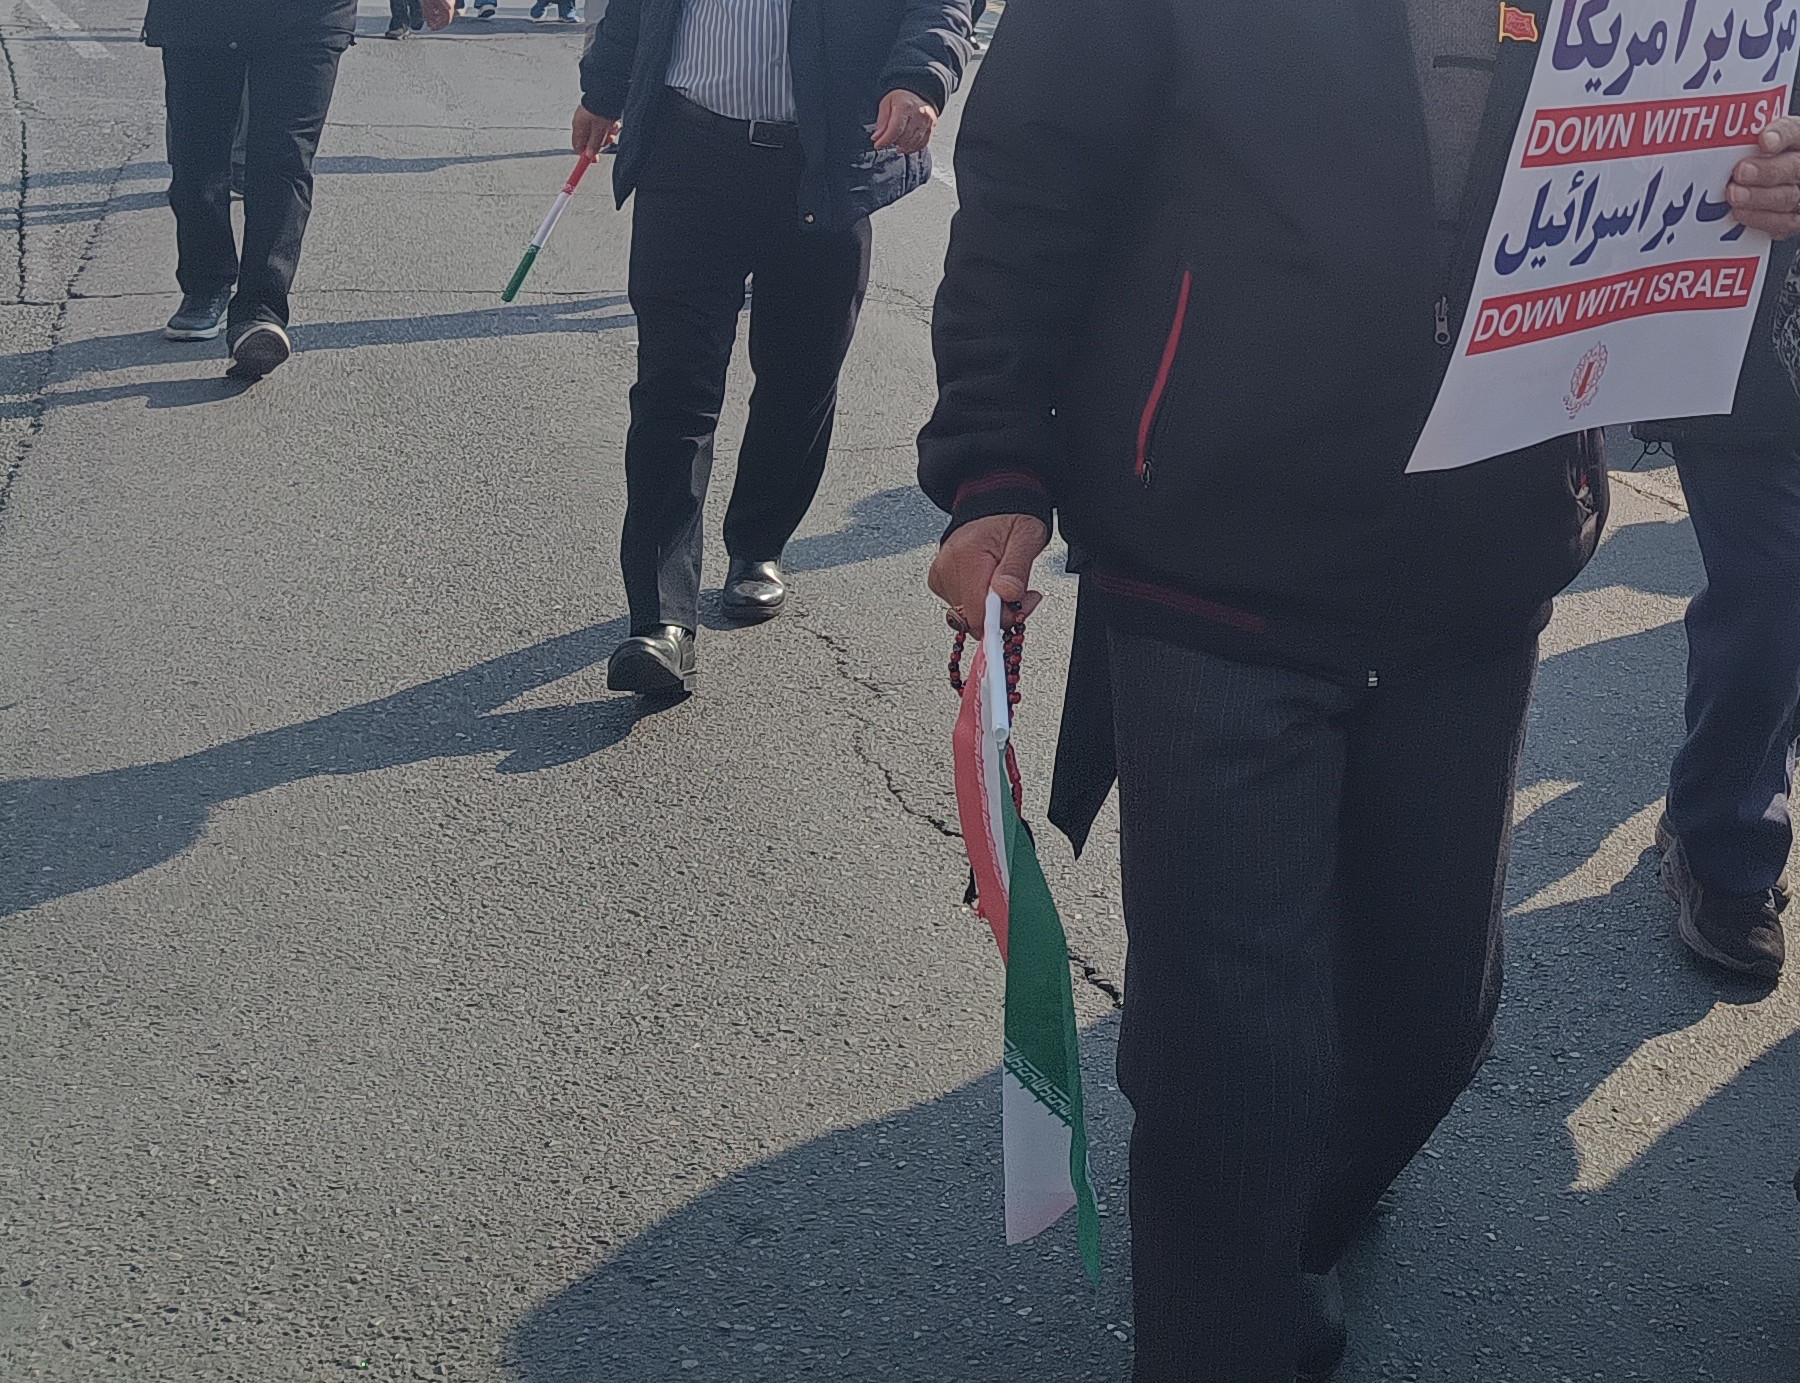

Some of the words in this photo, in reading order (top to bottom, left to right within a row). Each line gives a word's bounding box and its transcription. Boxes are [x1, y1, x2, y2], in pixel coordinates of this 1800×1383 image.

[1682, 8, 1735, 91] بر
[1526, 110, 1637, 157] DOWN
[1641, 104, 1718, 146] WITH
[1494, 165, 1665, 276] اسرائیل
[1640, 182, 1695, 253] بر
[1473, 294, 1573, 343] DOWN
[1576, 280, 1643, 319] WITH
[1644, 266, 1750, 306] ISRAEL
